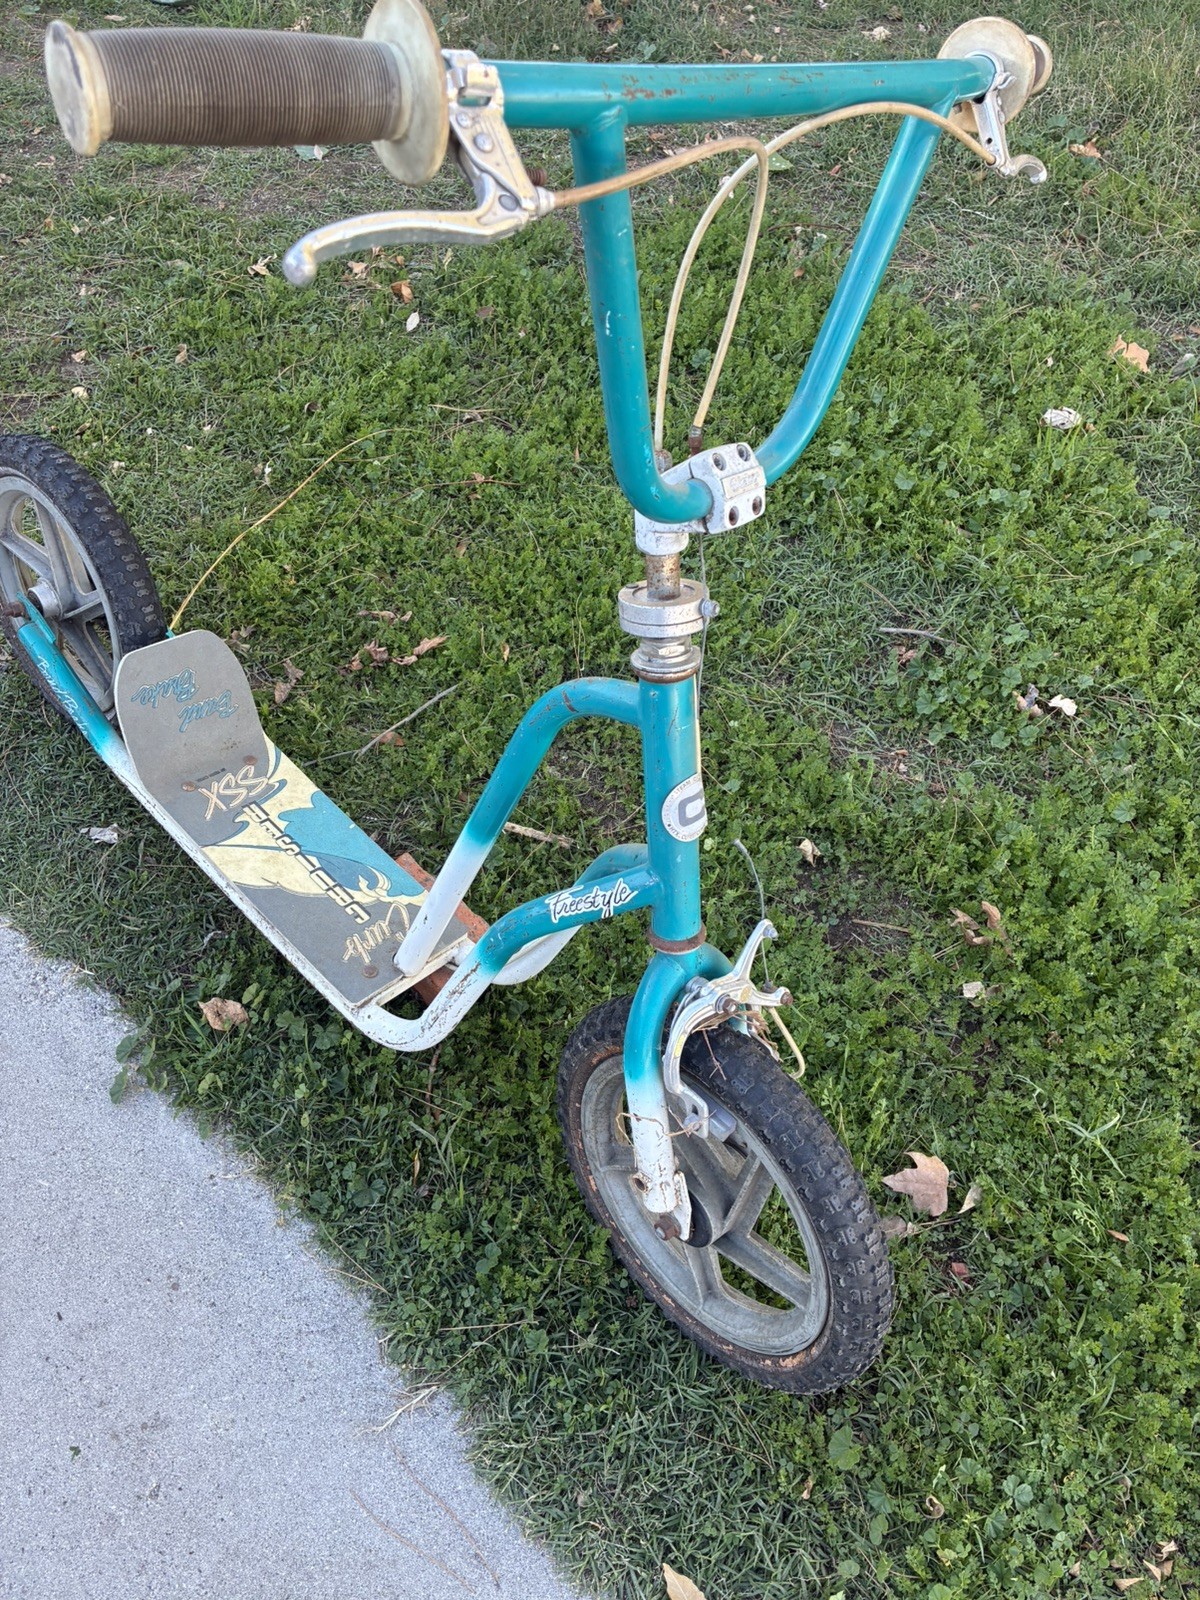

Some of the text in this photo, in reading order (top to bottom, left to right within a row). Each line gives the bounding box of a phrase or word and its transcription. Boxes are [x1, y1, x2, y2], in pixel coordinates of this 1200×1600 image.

[131, 667, 199, 708] Brake
[178, 690, 238, 733] Band
[198, 764, 269, 821] SSX
[242, 801, 372, 924] CRUISER
[545, 877, 639, 923] Freestyle
